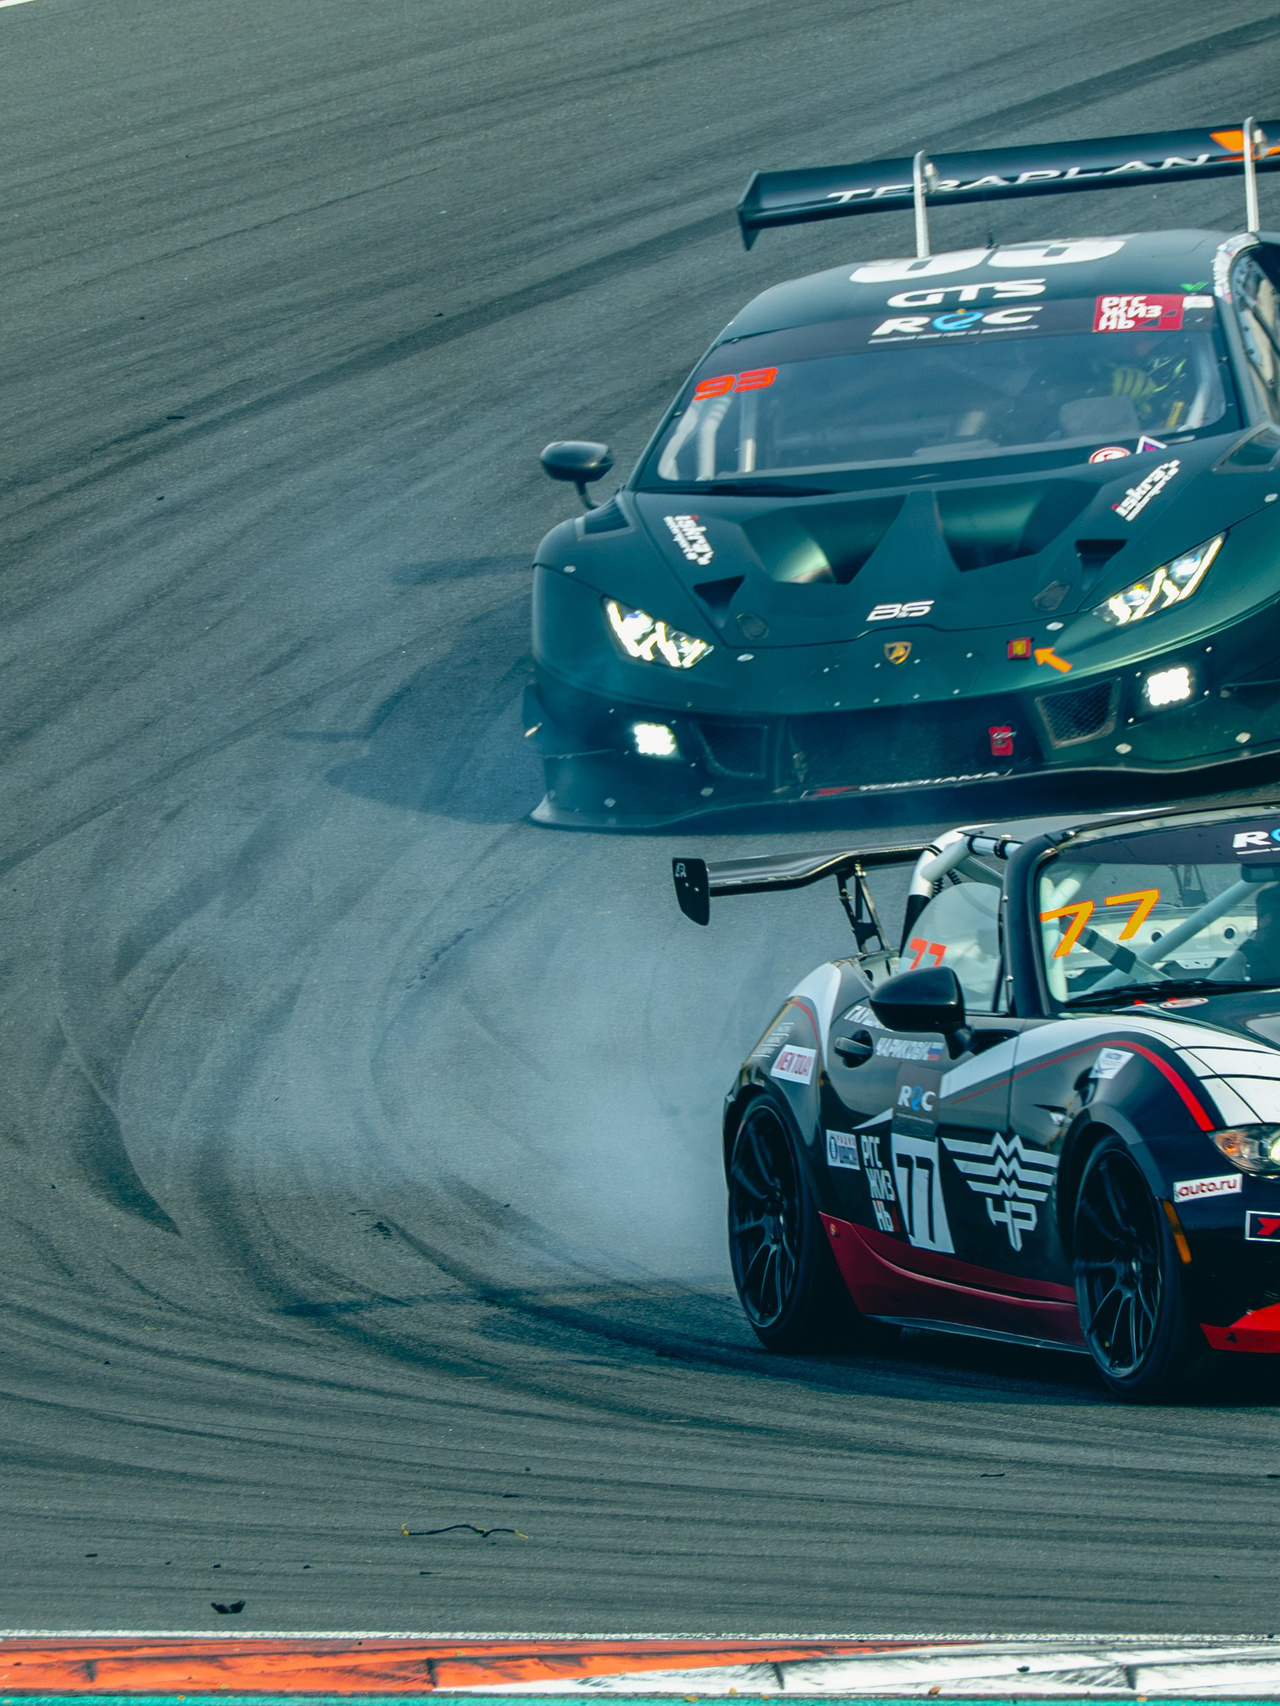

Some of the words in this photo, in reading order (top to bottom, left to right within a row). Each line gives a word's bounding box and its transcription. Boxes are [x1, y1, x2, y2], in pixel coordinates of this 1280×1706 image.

[887, 278, 1047, 308] GTS
[692, 366, 778, 401] 93
[1039, 888, 1160, 959] 77
[860, 1134, 883, 1168] РГС
[897, 1152, 936, 1244] 77
[1178, 1178, 1238, 1197] auto.ru
